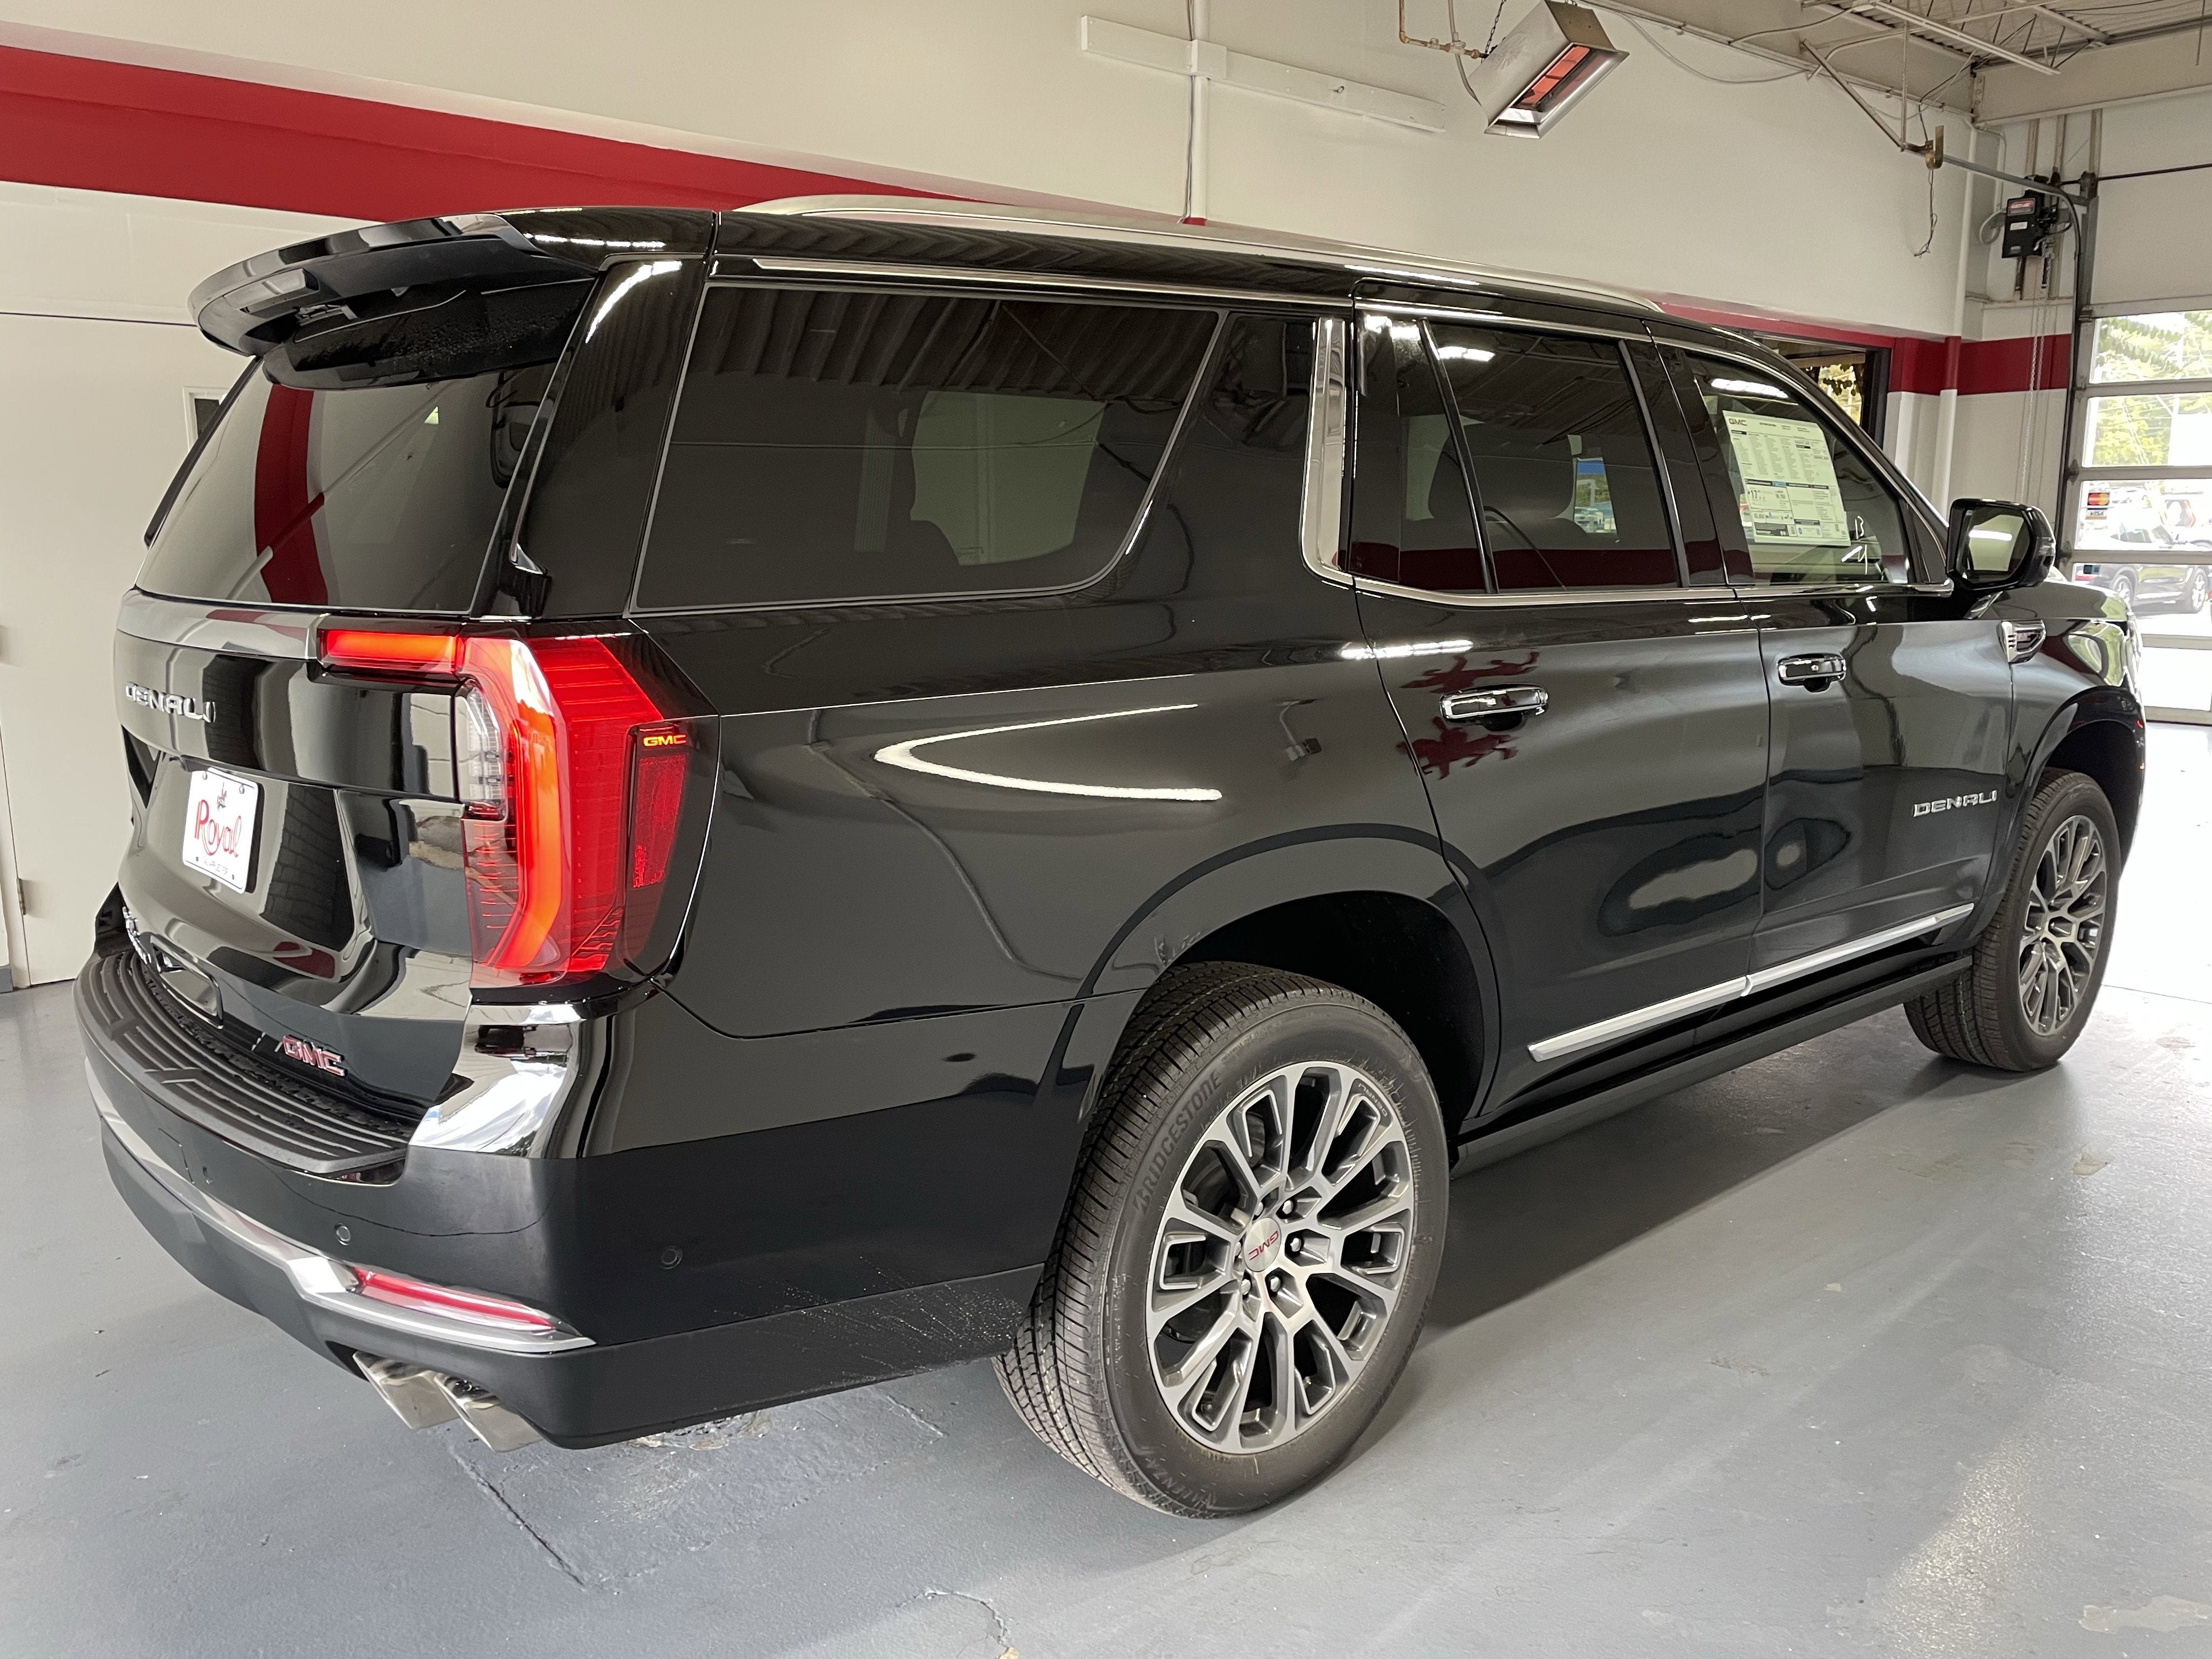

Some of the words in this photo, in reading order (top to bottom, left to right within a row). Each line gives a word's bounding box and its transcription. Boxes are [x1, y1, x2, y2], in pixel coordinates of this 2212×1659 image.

[1729, 418, 1747, 426] GMC
[125, 682, 216, 723] DENALI
[643, 735, 686, 747] GMC
[1912, 790, 1997, 817] DENALI
[194, 799, 241, 857] Royal
[283, 1035, 345, 1076] GMC
[1134, 1070, 1222, 1213] BRIDGESTONE
[1248, 1231, 1279, 1261] GMC
